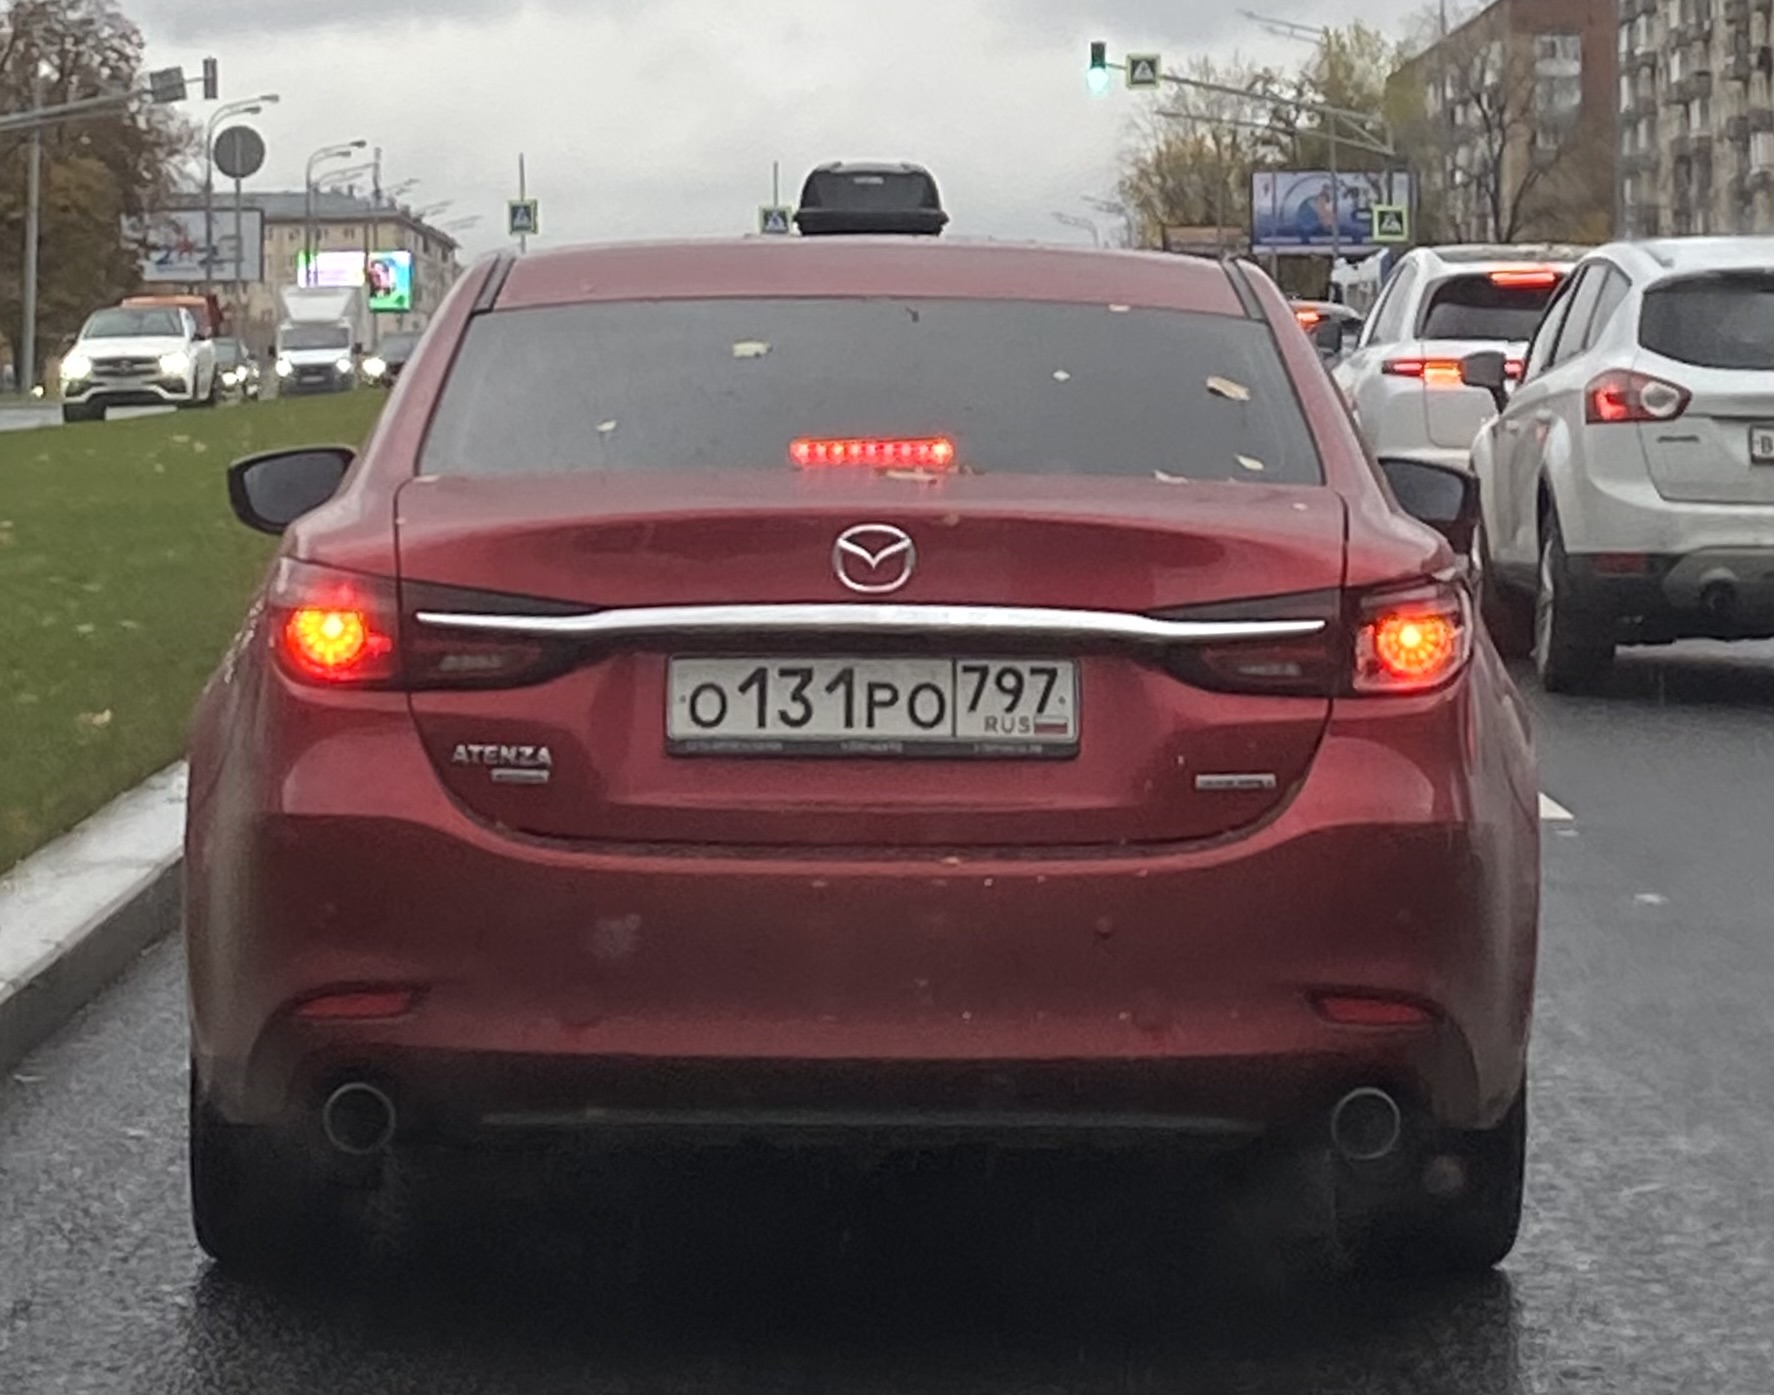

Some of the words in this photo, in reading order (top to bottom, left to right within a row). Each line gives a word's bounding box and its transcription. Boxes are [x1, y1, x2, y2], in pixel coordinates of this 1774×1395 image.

[961, 664, 1059, 714] 797
[984, 715, 1031, 734] RUS
[452, 744, 553, 767] ATENZA
